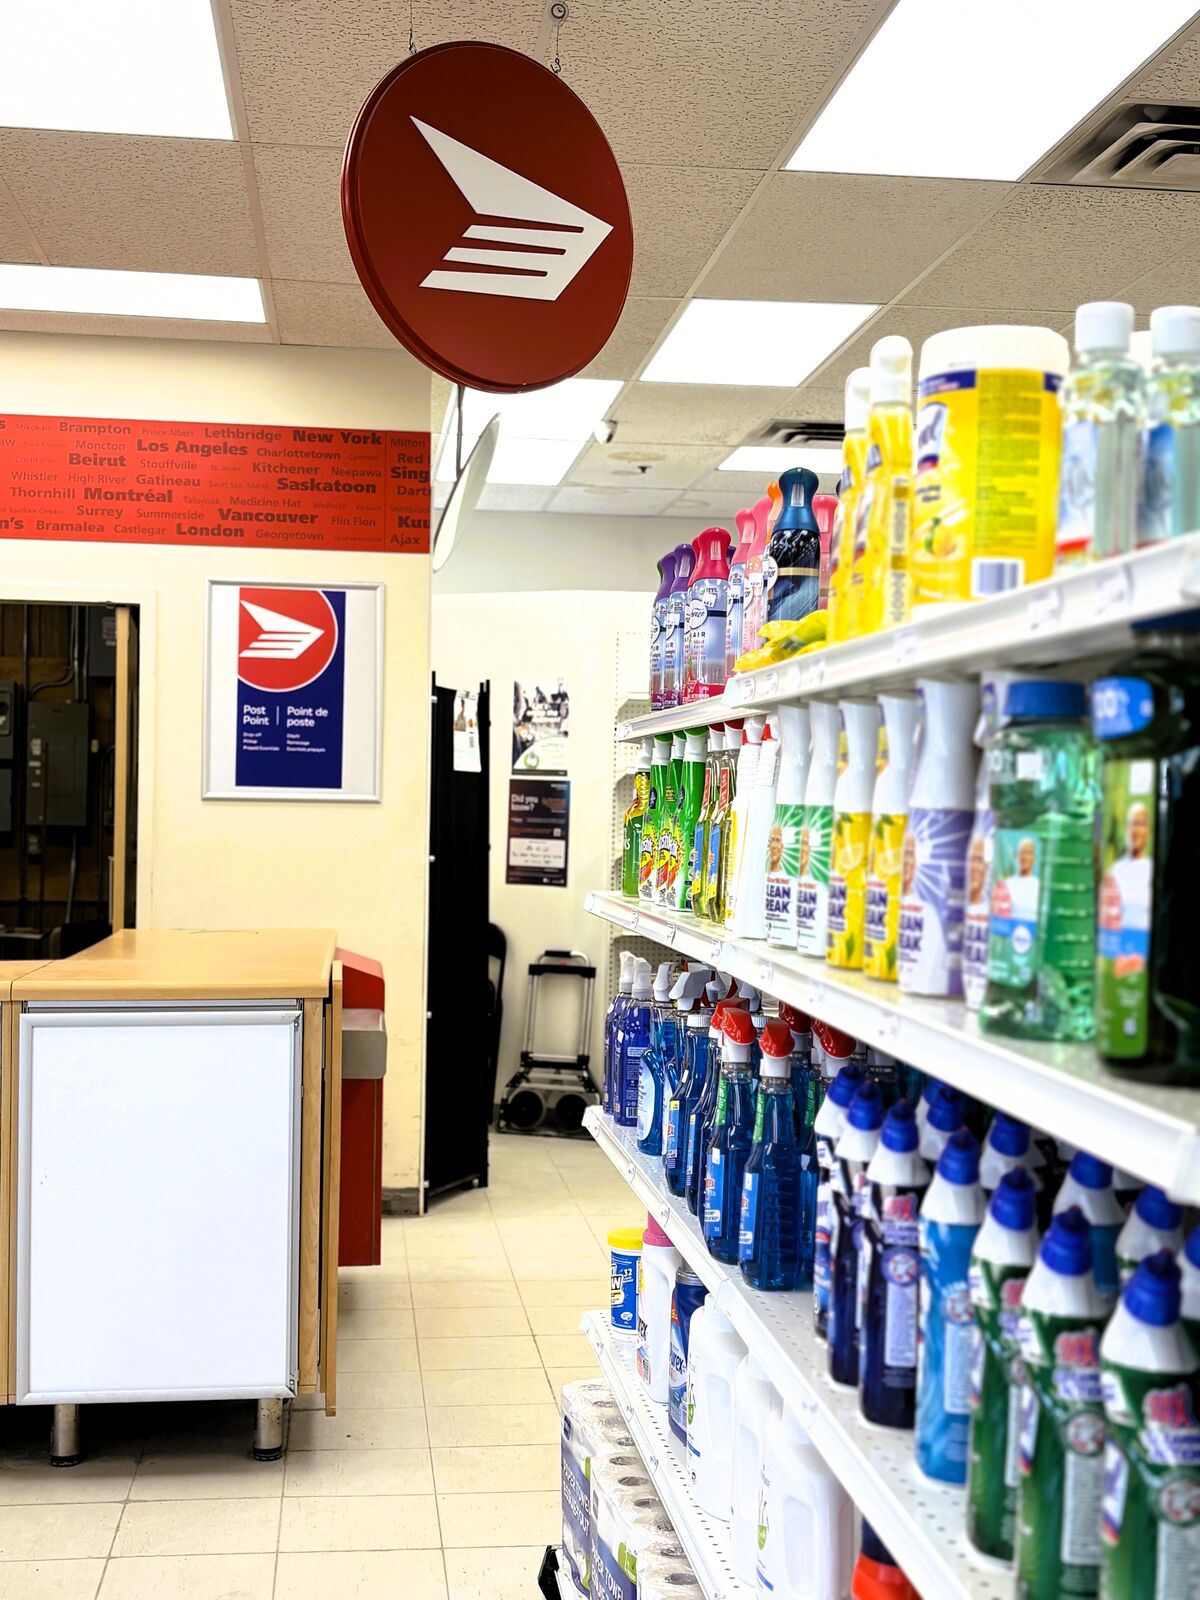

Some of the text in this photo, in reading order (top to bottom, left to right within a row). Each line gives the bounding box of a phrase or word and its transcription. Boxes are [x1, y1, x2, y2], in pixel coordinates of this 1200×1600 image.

[59, 421, 132, 436] Brampton
[204, 427, 282, 443] Lethbridge
[292, 430, 383, 446] New York
[390, 437, 426, 449] Milton
[75, 440, 126, 451] Moncton
[136, 439, 249, 457] Los Angeles
[68, 453, 127, 467] Beirut
[256, 448, 341, 461] Charlottetown
[397, 453, 423, 464] Red
[139, 459, 197, 471] Stouffville
[252, 462, 320, 476] Kitchener
[11, 471, 59, 482] Whistler
[68, 472, 126, 485] High River
[331, 467, 382, 479] Neepawa
[136, 474, 201, 488] Gatineau
[276, 477, 377, 494] Saskatoon
[10, 487, 76, 500] Thornhill
[84, 486, 173, 504] Montréal
[229, 496, 302, 509] Medicine Hat
[76, 505, 124, 520] Surrey
[136, 508, 205, 521] Summerside
[218, 508, 319, 524] Vancouver
[35, 520, 105, 534] Bramalea
[331, 516, 376, 528] Flin Flon
[114, 524, 166, 537] Castlegar
[176, 523, 245, 538] London
[255, 529, 325, 542] Georgetown
[390, 534, 421, 547] Ajax
[243, 704, 267, 715] Post
[287, 706, 329, 717] Point de
[243, 715, 270, 726] Point
[286, 718, 316, 728] poste
[511, 794, 525, 804] Did
